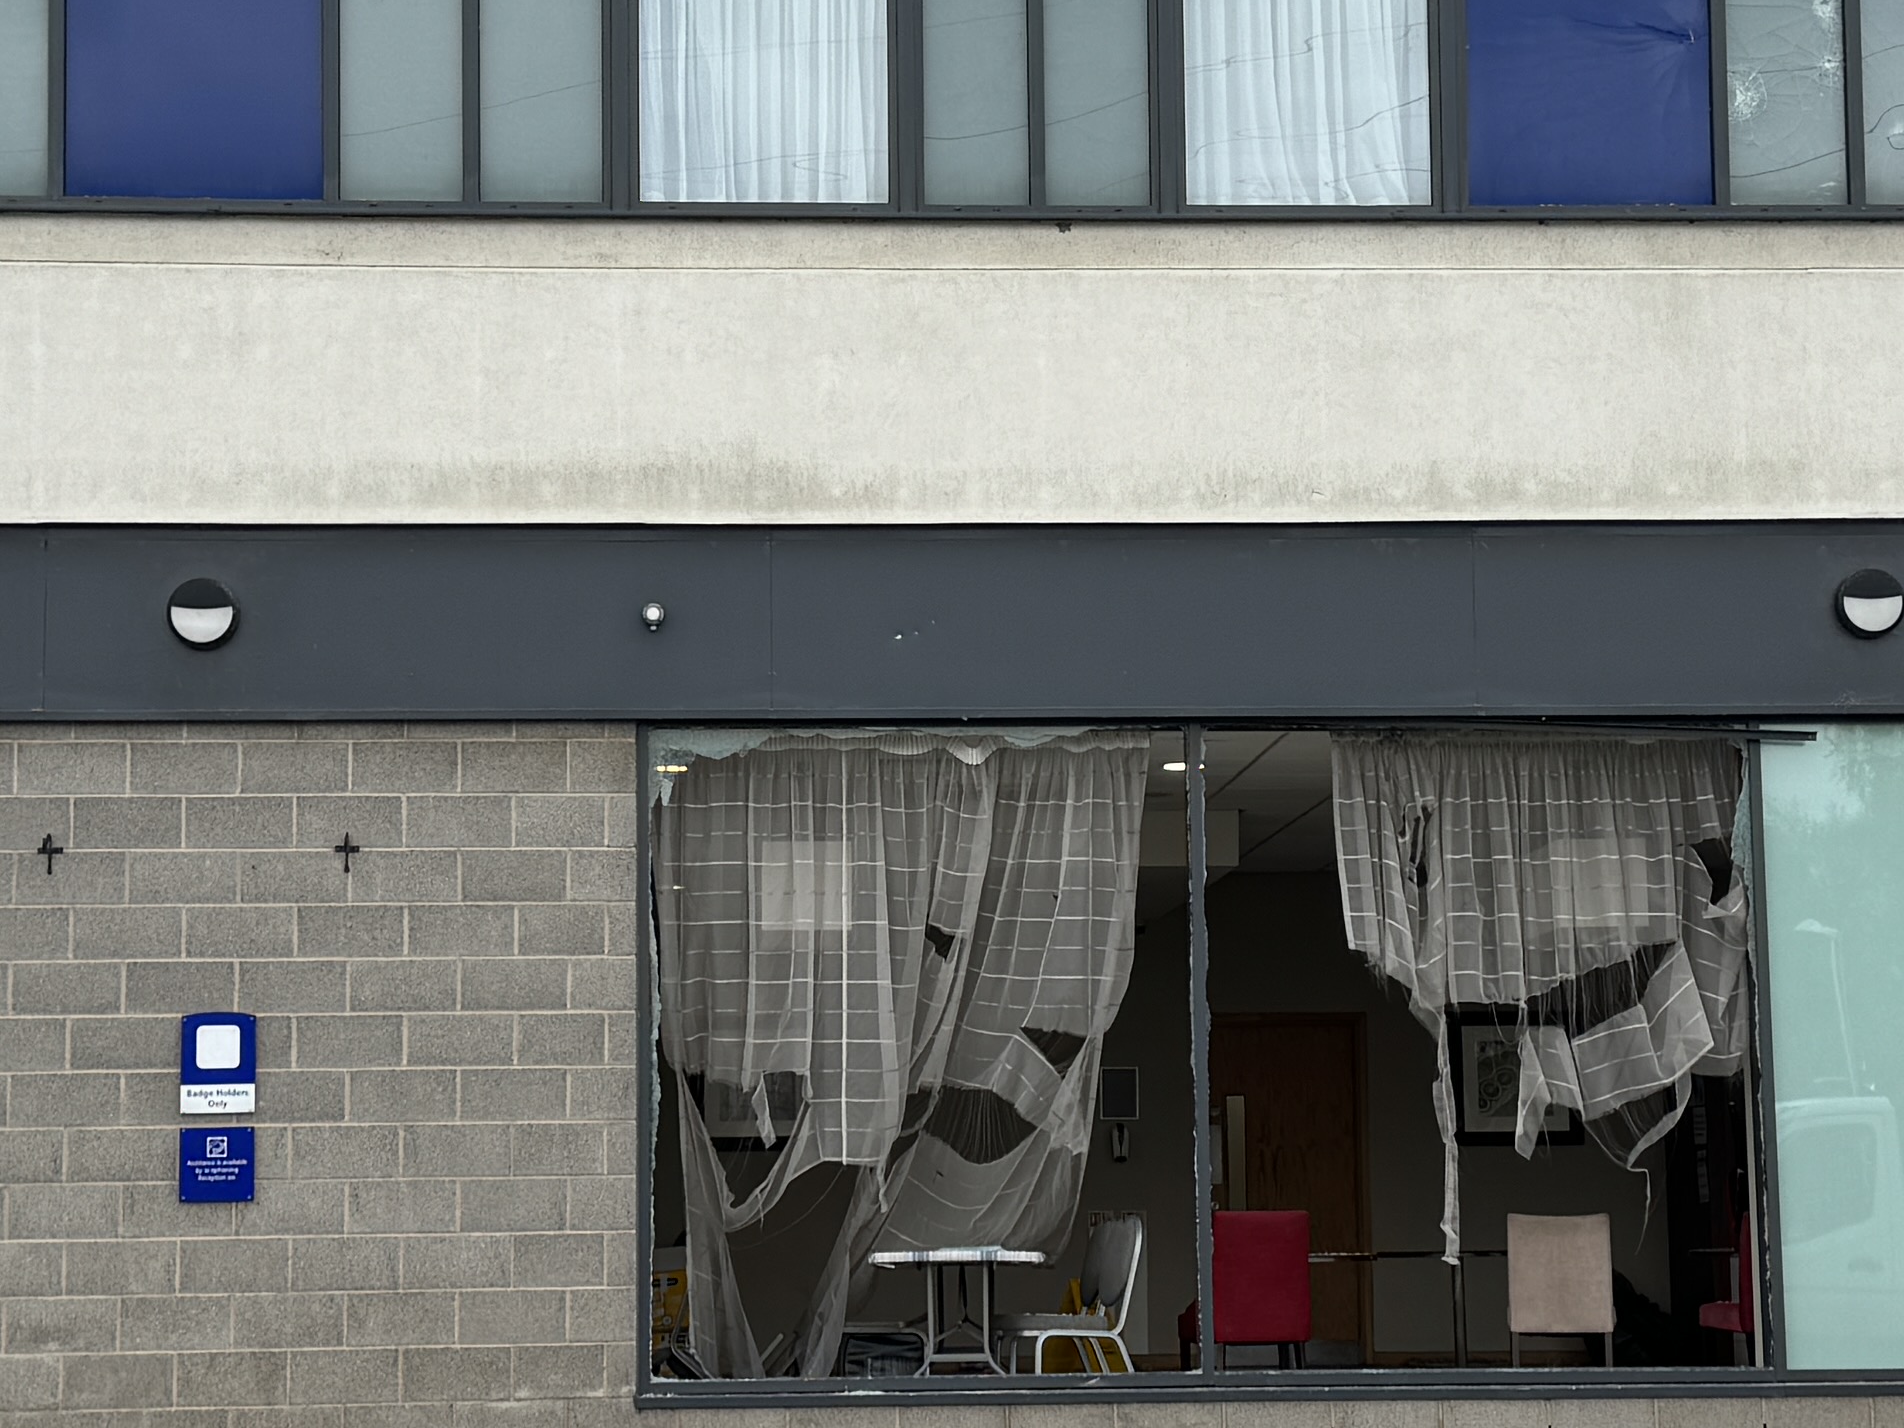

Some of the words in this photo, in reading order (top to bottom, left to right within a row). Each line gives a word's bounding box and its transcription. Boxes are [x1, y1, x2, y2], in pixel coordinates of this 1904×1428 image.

[186, 1089, 213, 1099] Badge
[216, 1088, 249, 1097] Holders
[208, 1099, 228, 1109] Only
